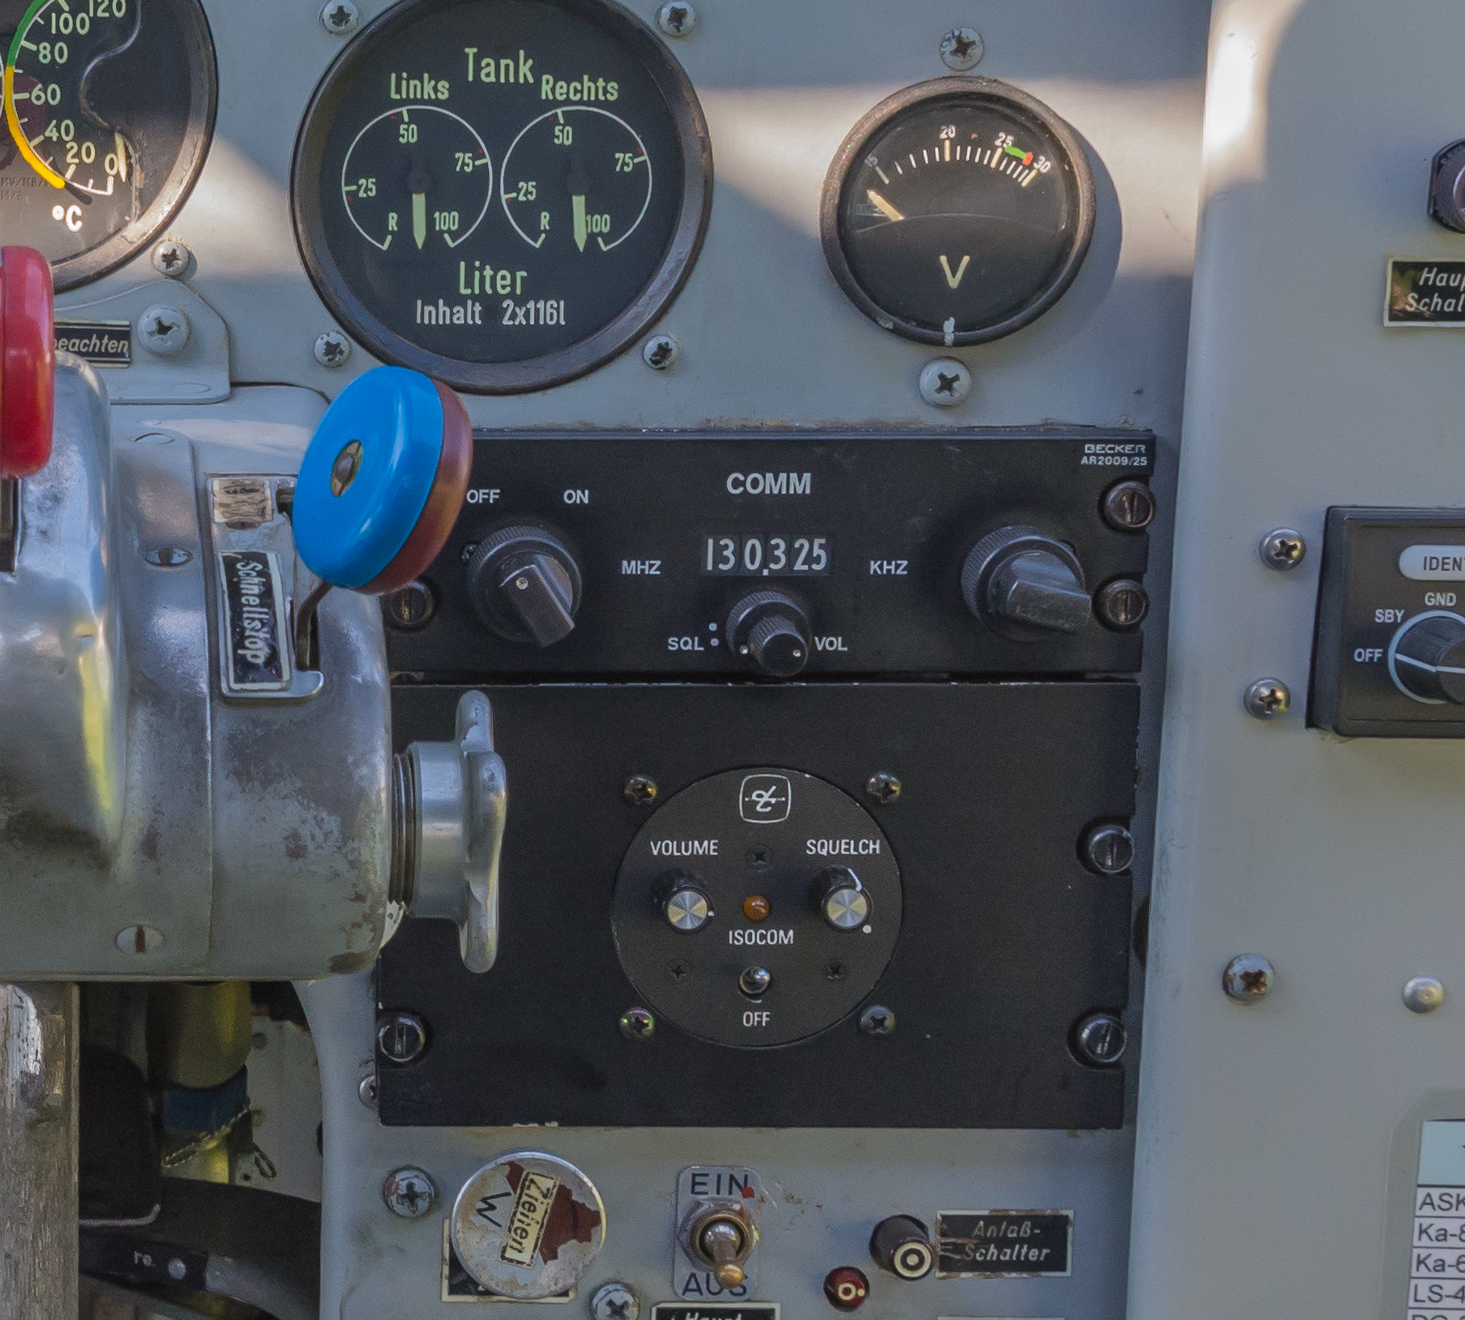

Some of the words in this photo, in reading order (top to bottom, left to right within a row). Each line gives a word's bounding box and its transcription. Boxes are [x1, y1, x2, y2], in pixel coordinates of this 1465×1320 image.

[51, 12, 89, 34] 100
[465, 47, 534, 84] Tank
[390, 73, 449, 100] Links
[541, 75, 619, 101] Rechts
[30, 86, 60, 105] 60
[459, 261, 528, 295] Liter
[416, 299, 482, 325] Inhalt
[726, 472, 811, 495] COMM
[467, 489, 501, 504] OFF
[563, 489, 589, 505] ON
[622, 560, 661, 576] MHZ
[869, 560, 908, 576] KHZ
[1424, 591, 1457, 608] GND
[237, 559, 271, 664] Schnellstop
[1374, 608, 1405, 625] SBY
[668, 636, 704, 652] SQL
[815, 636, 848, 652] VOL
[1353, 647, 1383, 664] OFF
[650, 840, 718, 856] VOLUME
[806, 839, 880, 855] SQUELCH
[728, 930, 794, 945] ISOCOM
[689, 1173, 750, 1197] EIN
